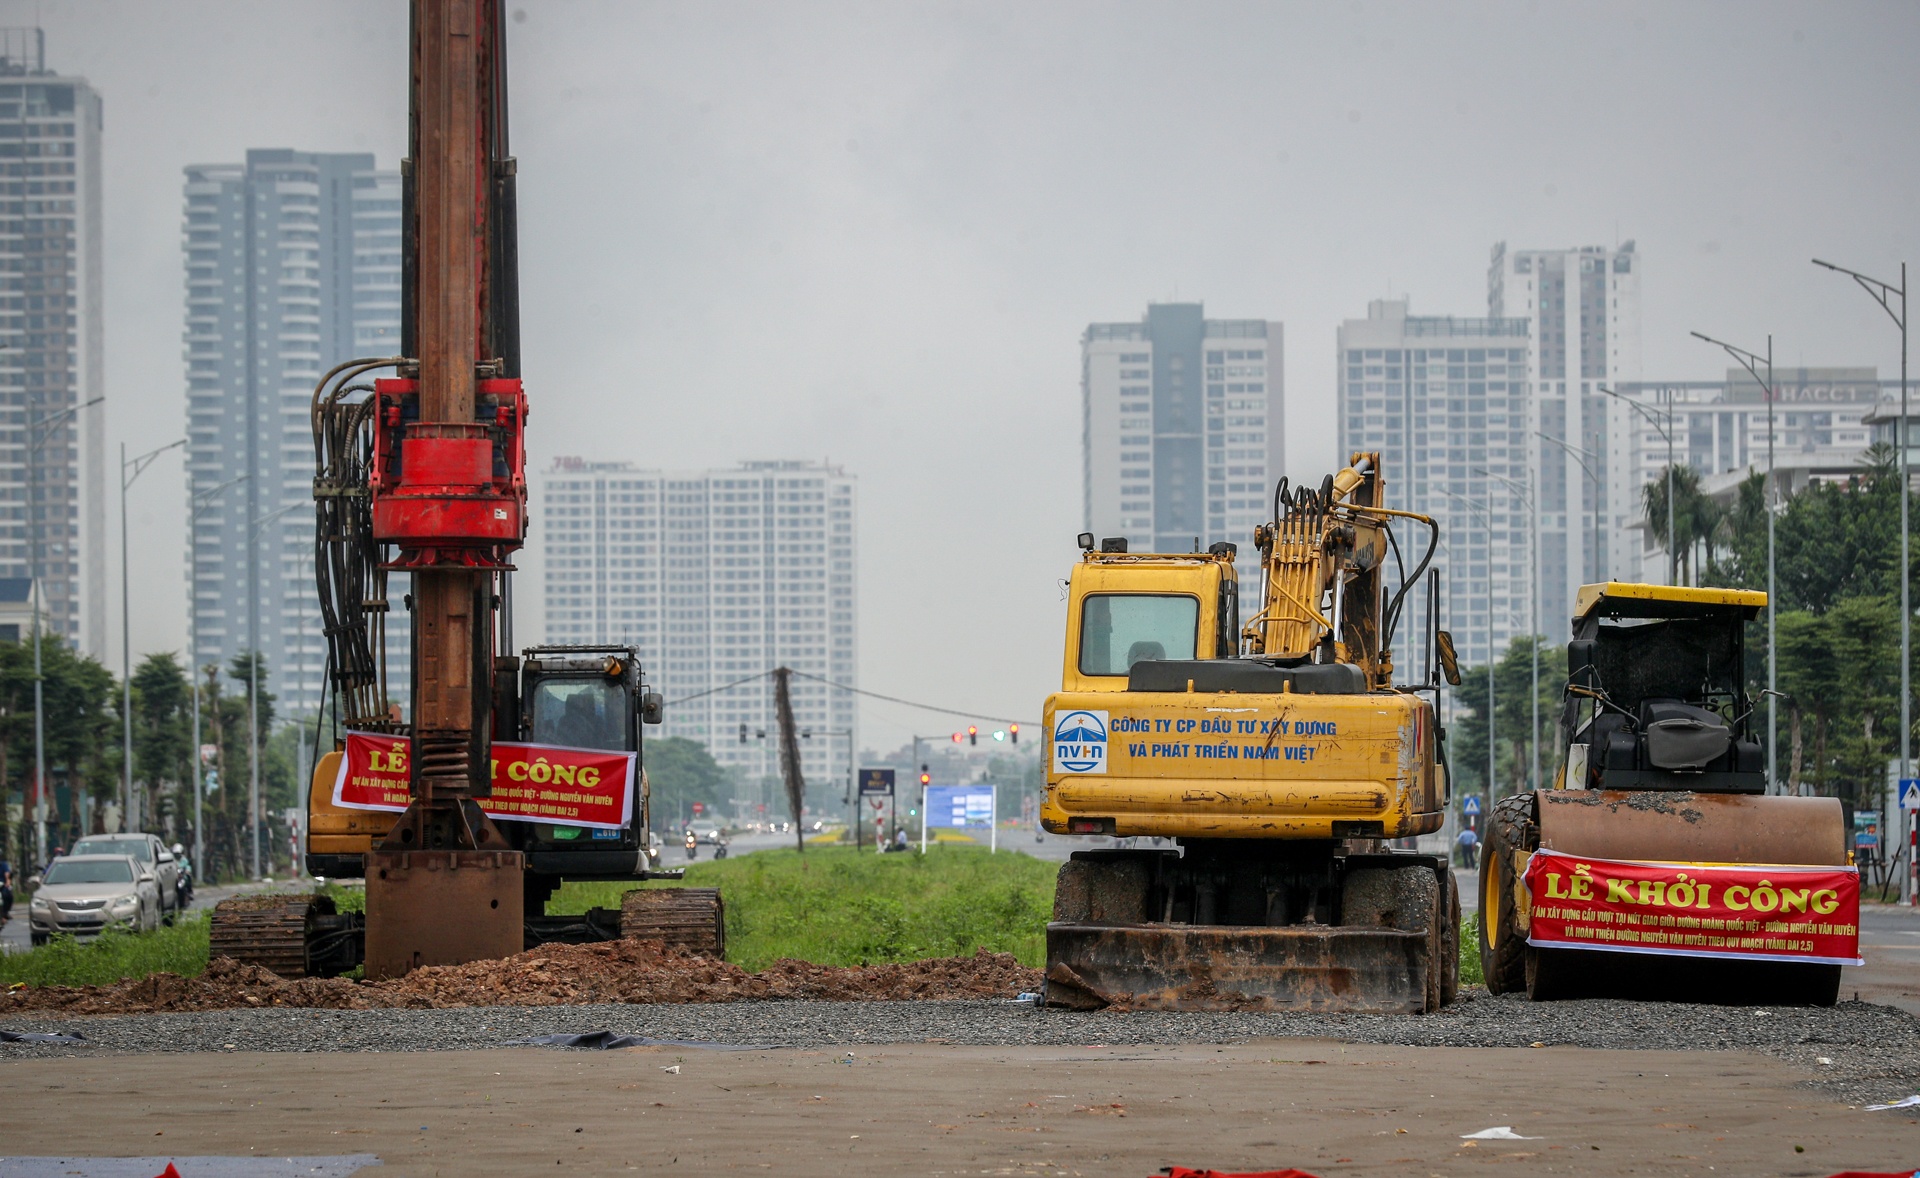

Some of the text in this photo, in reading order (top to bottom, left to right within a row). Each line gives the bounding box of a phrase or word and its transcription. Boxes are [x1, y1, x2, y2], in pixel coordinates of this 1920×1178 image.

[1111, 715, 1337, 738] CÔNG TY CP ĐẦU TƯ XÂY DỰNG
[1129, 739, 1316, 763] VÀ PHÁT TRIỂN NAM VIỆT
[368, 742, 407, 773] LỄ
[508, 757, 601, 788] CÔNG
[361, 776, 369, 787] ÁN
[495, 801, 508, 811] THEO
[508, 802, 519, 812] QUY
[1545, 863, 1840, 915] LỄ KHỞI CÔNG
[1535, 904, 1546, 918] ÁN
[1546, 905, 1561, 919] XÂY
[1562, 908, 1580, 922] DỰNG
[1597, 910, 1614, 925] VƯỢT
[1615, 912, 1627, 926] TẠI
[1627, 912, 1641, 925] NÚT
[1642, 914, 1658, 926] GIAO
[1659, 914, 1676, 927] GIỮA
[1677, 915, 1701, 929] ĐƯỜNG
[1701, 917, 1725, 931] HOÀNG
[1726, 917, 1744, 932] QUỐC
[1745, 919, 1760, 934] VIỆT
[1765, 920, 1789, 933] ĐƯỜNG
[1790, 920, 1817, 934] NGUYỄN
[1818, 922, 1832, 935] VĂN
[1833, 923, 1857, 936] HUYÊN
[1565, 925, 1814, 953] VÀ HOÀN THIỆN ĐƯỜNG NGUYỄN VĂN HUYÊN THEO QUY HOẠCH (VÀNH ĐAI 2,5)
